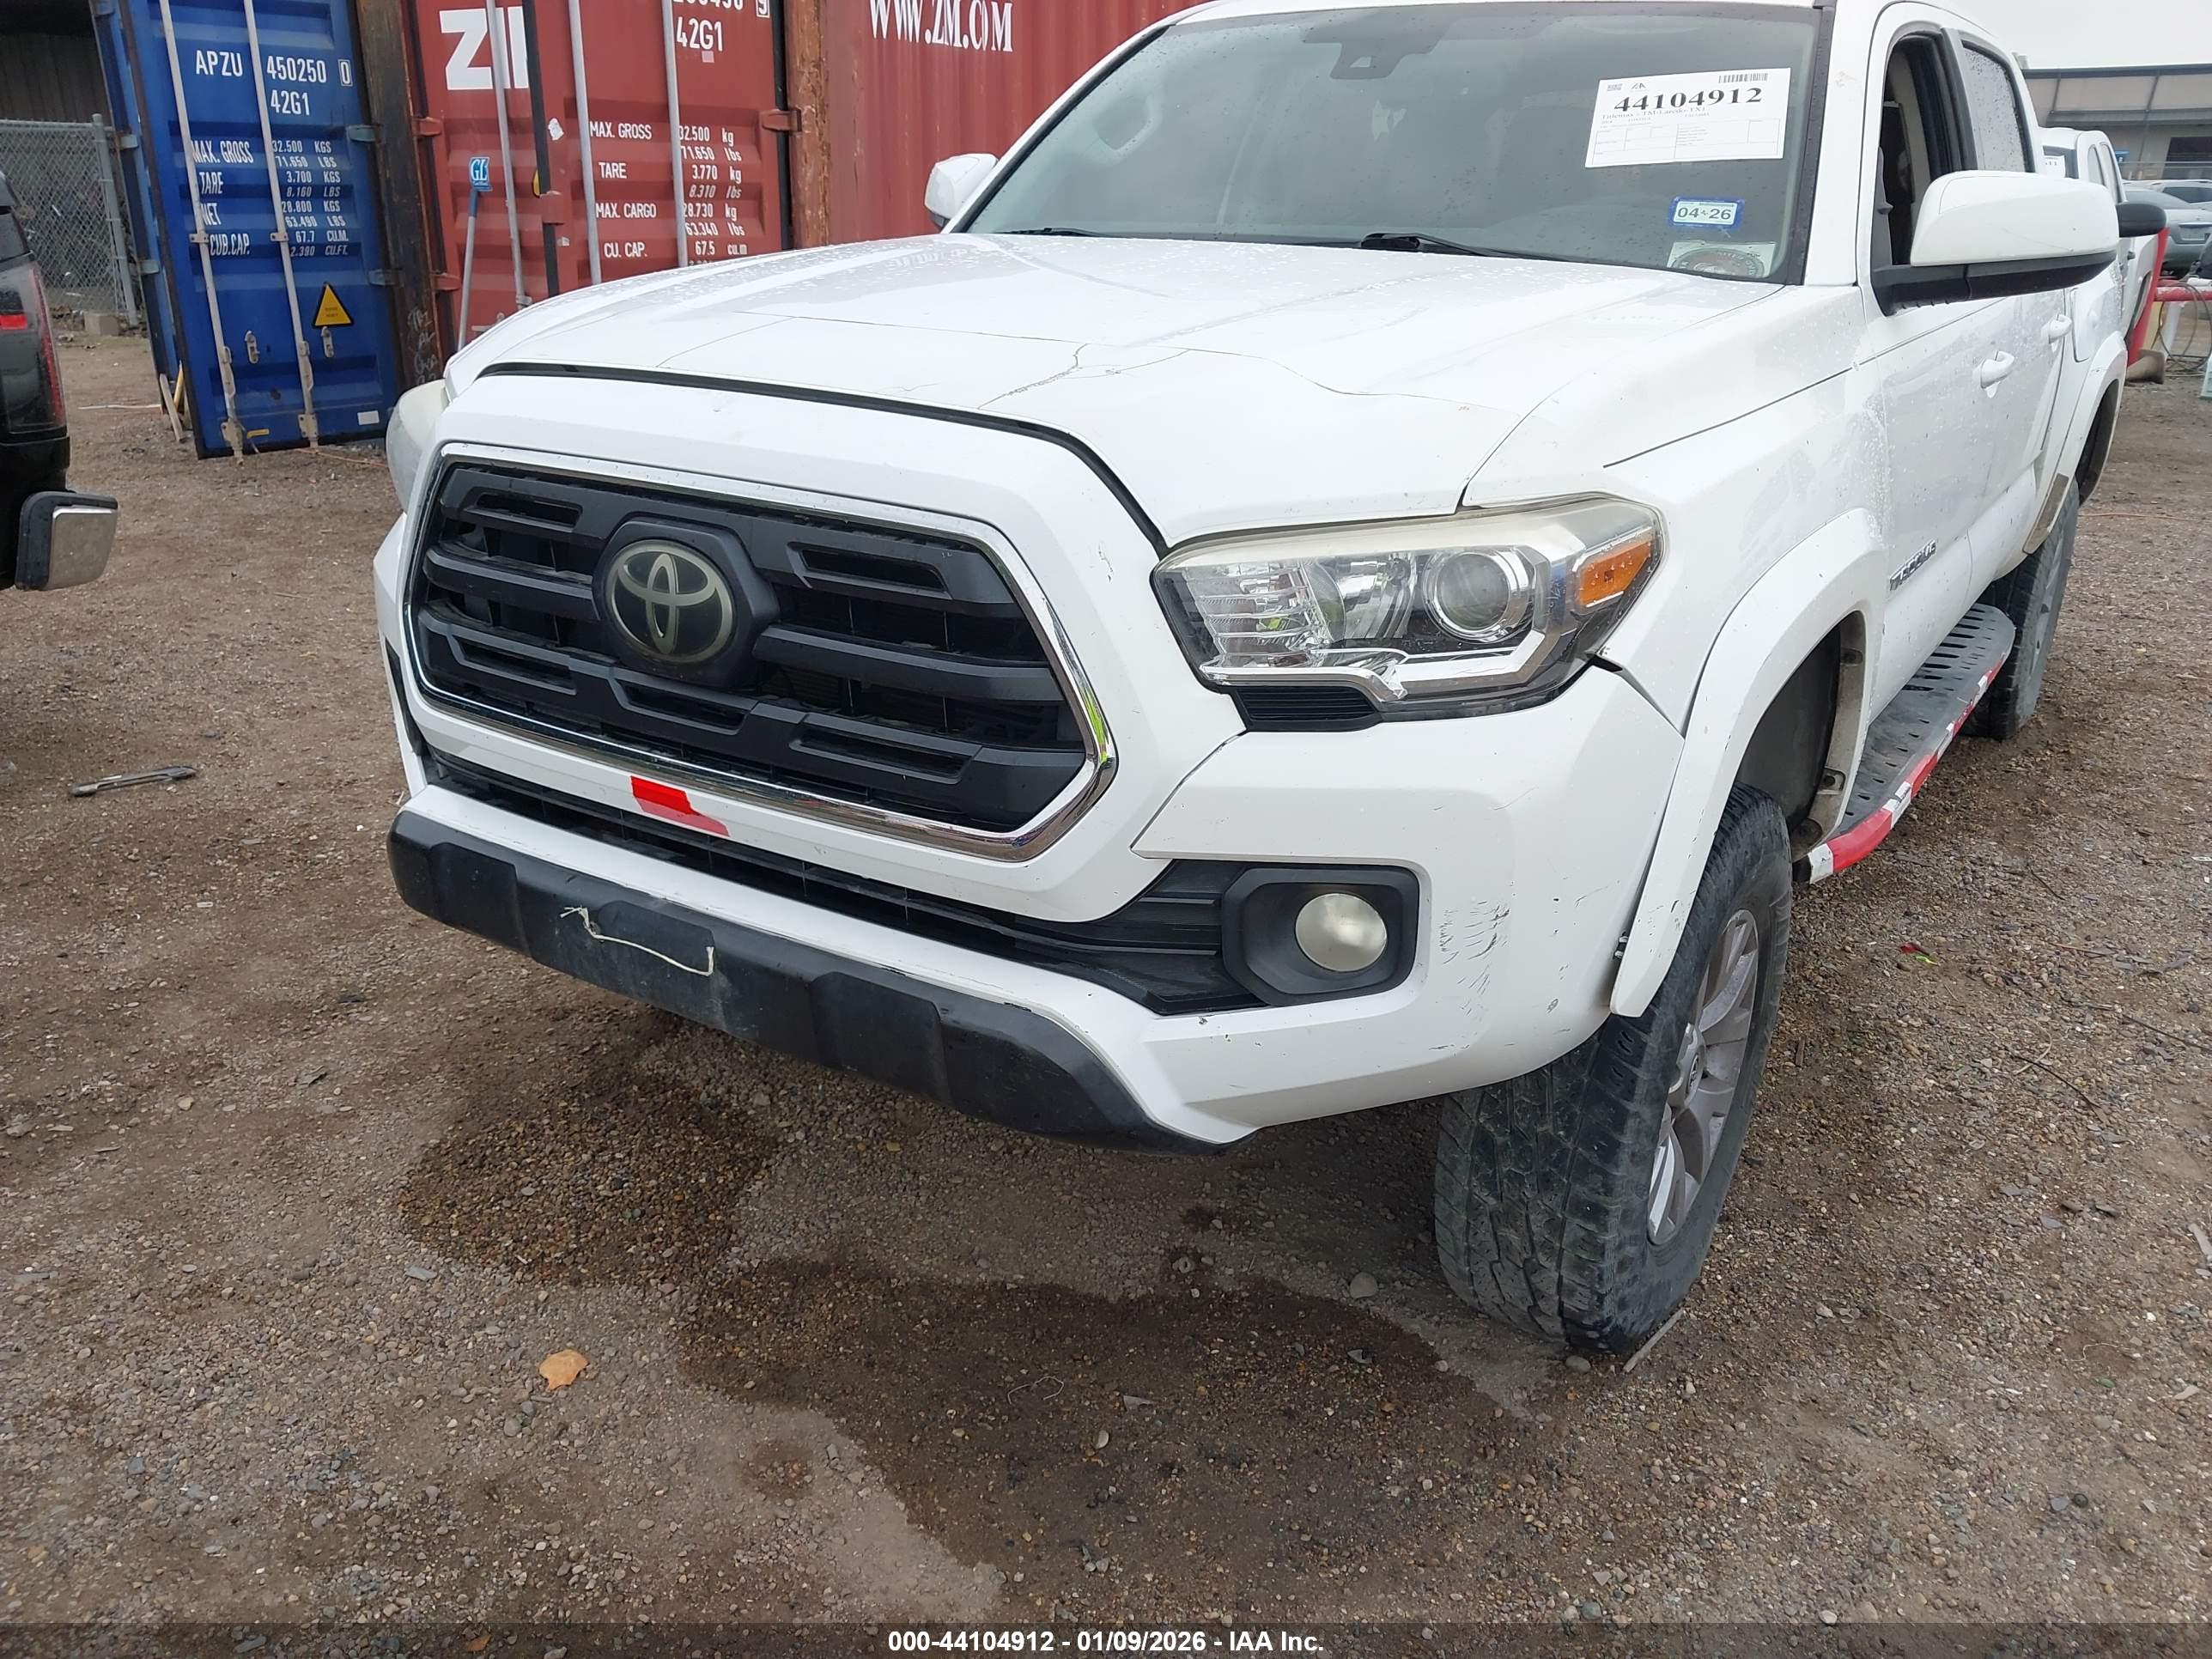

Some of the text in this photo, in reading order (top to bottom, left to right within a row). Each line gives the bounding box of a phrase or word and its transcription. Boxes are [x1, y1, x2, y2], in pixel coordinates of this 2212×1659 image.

[676, 16, 723, 52] 42G1
[196, 50, 243, 77] APZU
[266, 56, 326, 83] 450250
[270, 89, 310, 116] 42G1
[1613, 88, 1762, 112] 44104912
[589, 121, 734, 147] MAX. GROSS 32.500 kg
[191, 140, 331, 164] MAX. GROSS 32.500 KGS
[276, 155, 337, 168] 71.650 LBS
[680, 145, 742, 162] 71.650 lbs
[199, 172, 224, 195] TARE
[323, 171, 341, 184] KGS
[599, 161, 742, 185] TARE 3.770 kg
[323, 186, 341, 198] LBS
[689, 185, 742, 198] 8.310 lbs
[200, 203, 222, 227] NET
[323, 200, 341, 213] KGS
[326, 216, 346, 228] LBS
[595, 203, 738, 221] MAX. CARGO 28.730 kg
[1677, 207, 1732, 220] 04 26
[686, 222, 745, 236] 63.340 lbs
[210, 233, 251, 257] CUB.CAP.
[295, 230, 315, 243] 67.7
[604, 242, 622, 258] CU.
[624, 241, 648, 258] CAP.
[695, 240, 715, 256] 67.5
